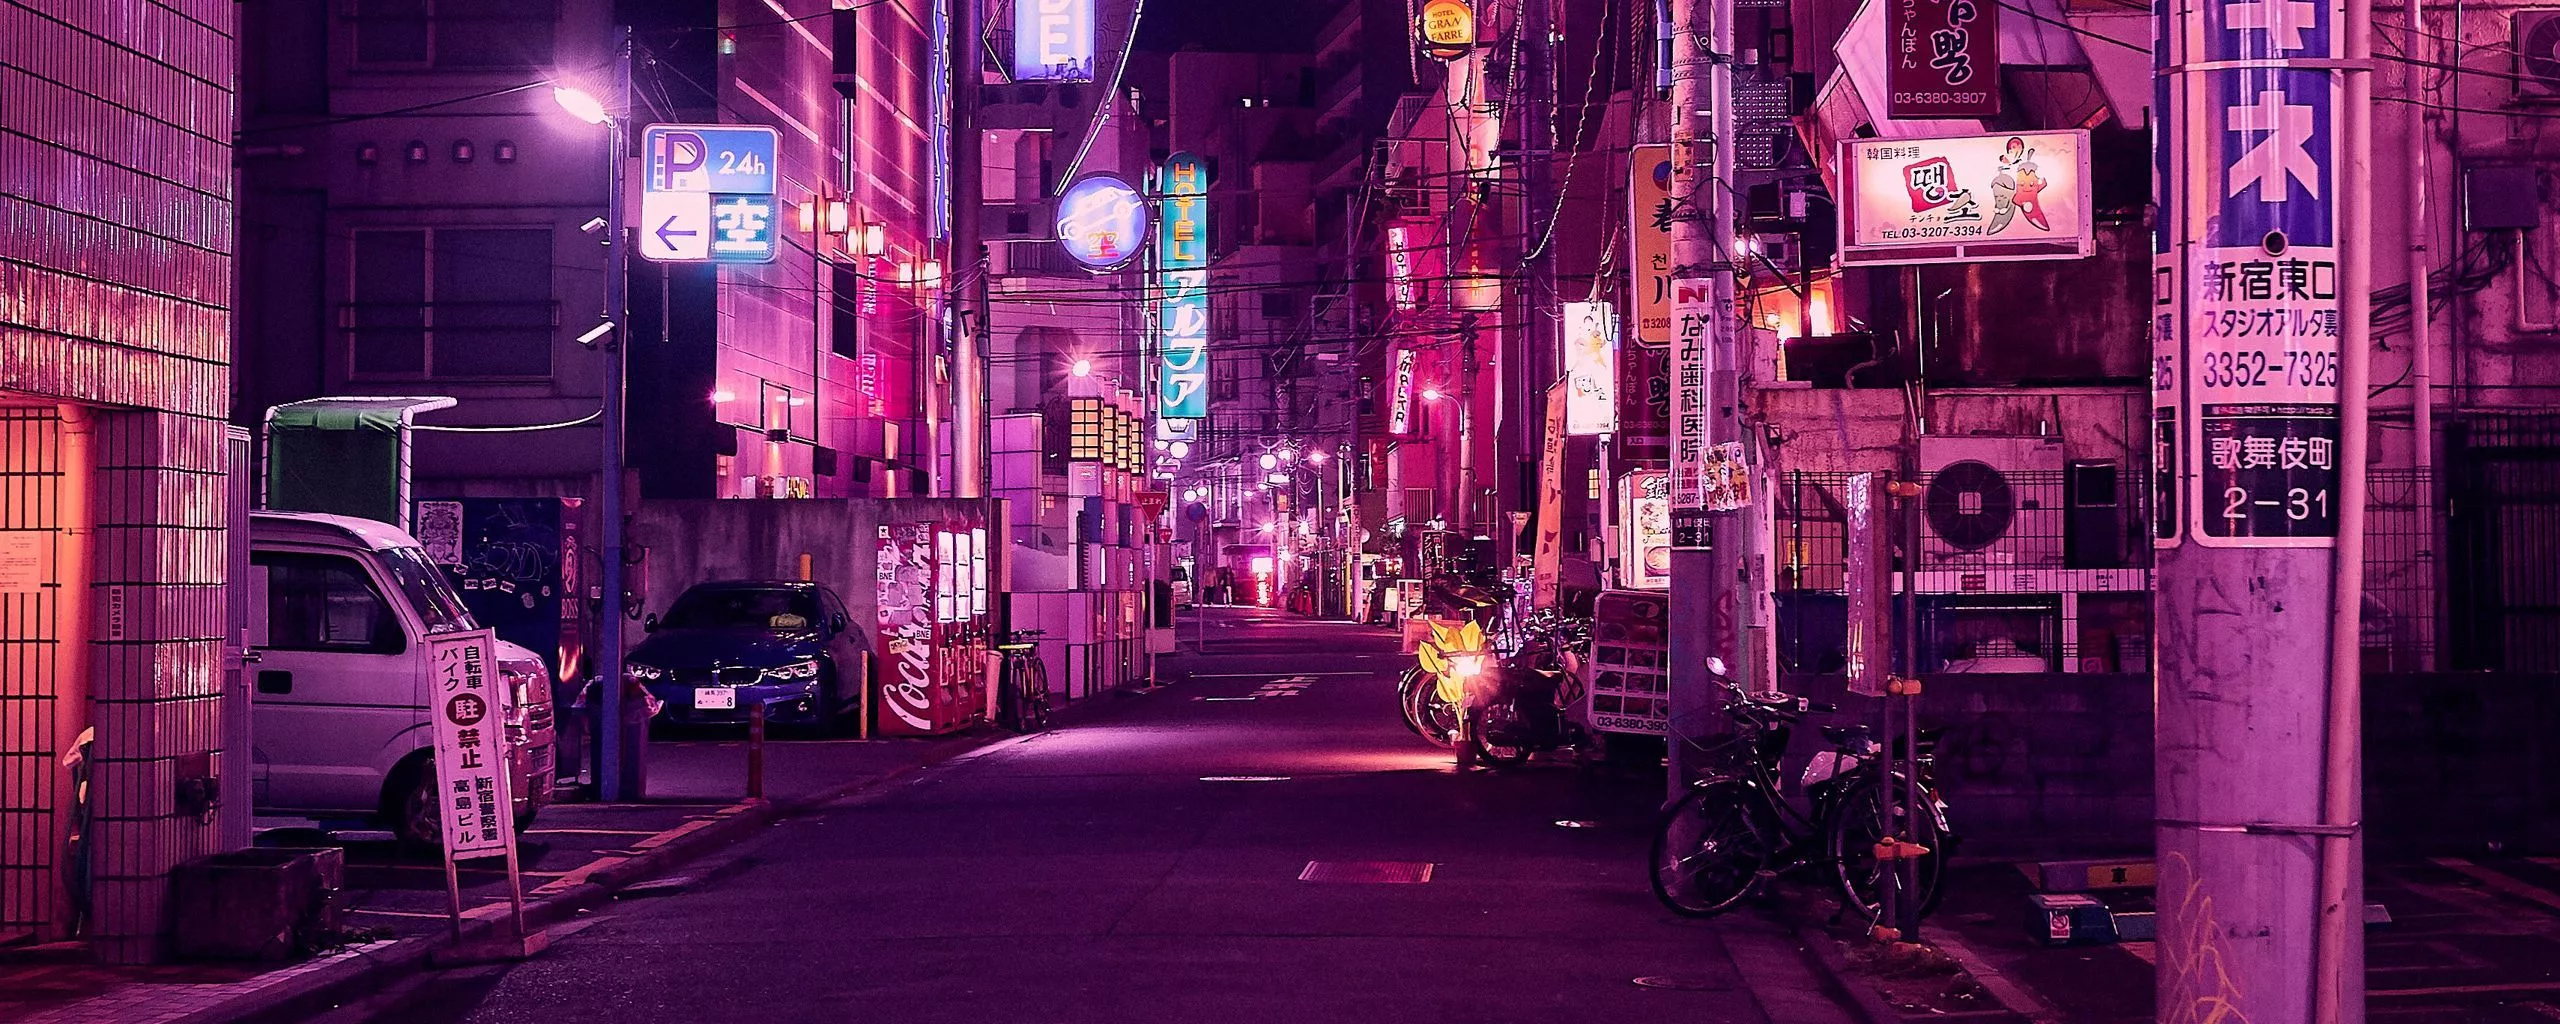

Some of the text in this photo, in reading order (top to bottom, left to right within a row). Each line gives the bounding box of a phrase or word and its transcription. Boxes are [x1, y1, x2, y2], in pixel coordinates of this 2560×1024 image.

[1428, 17, 1462, 29] GRAN
[1432, 9, 1455, 18] HOTEL
[1894, 92, 1987, 104] 03-6380-3907
[719, 150, 766, 175] 24h
[1867, 146, 1920, 160] 韓国料理
[714, 196, 769, 252] 空
[1174, 162, 1195, 260] HOTEL
[2203, 258, 2337, 302] 新宿東口
[2203, 308, 2338, 338] スタジオアルタ裏
[2203, 350, 2339, 389] 3352-7325
[1680, 313, 1706, 463] なみ歯科医院
[2211, 436, 2333, 471] 歌舞伎町
[2222, 486, 2327, 520] 2-31
[1678, 531, 1710, 544] 2-31
[879, 572, 893, 580] BNE
[917, 629, 930, 639] BNE
[441, 648, 460, 692] バイク
[464, 645, 483, 690] 自転車
[453, 779, 476, 844] 高島ビル
